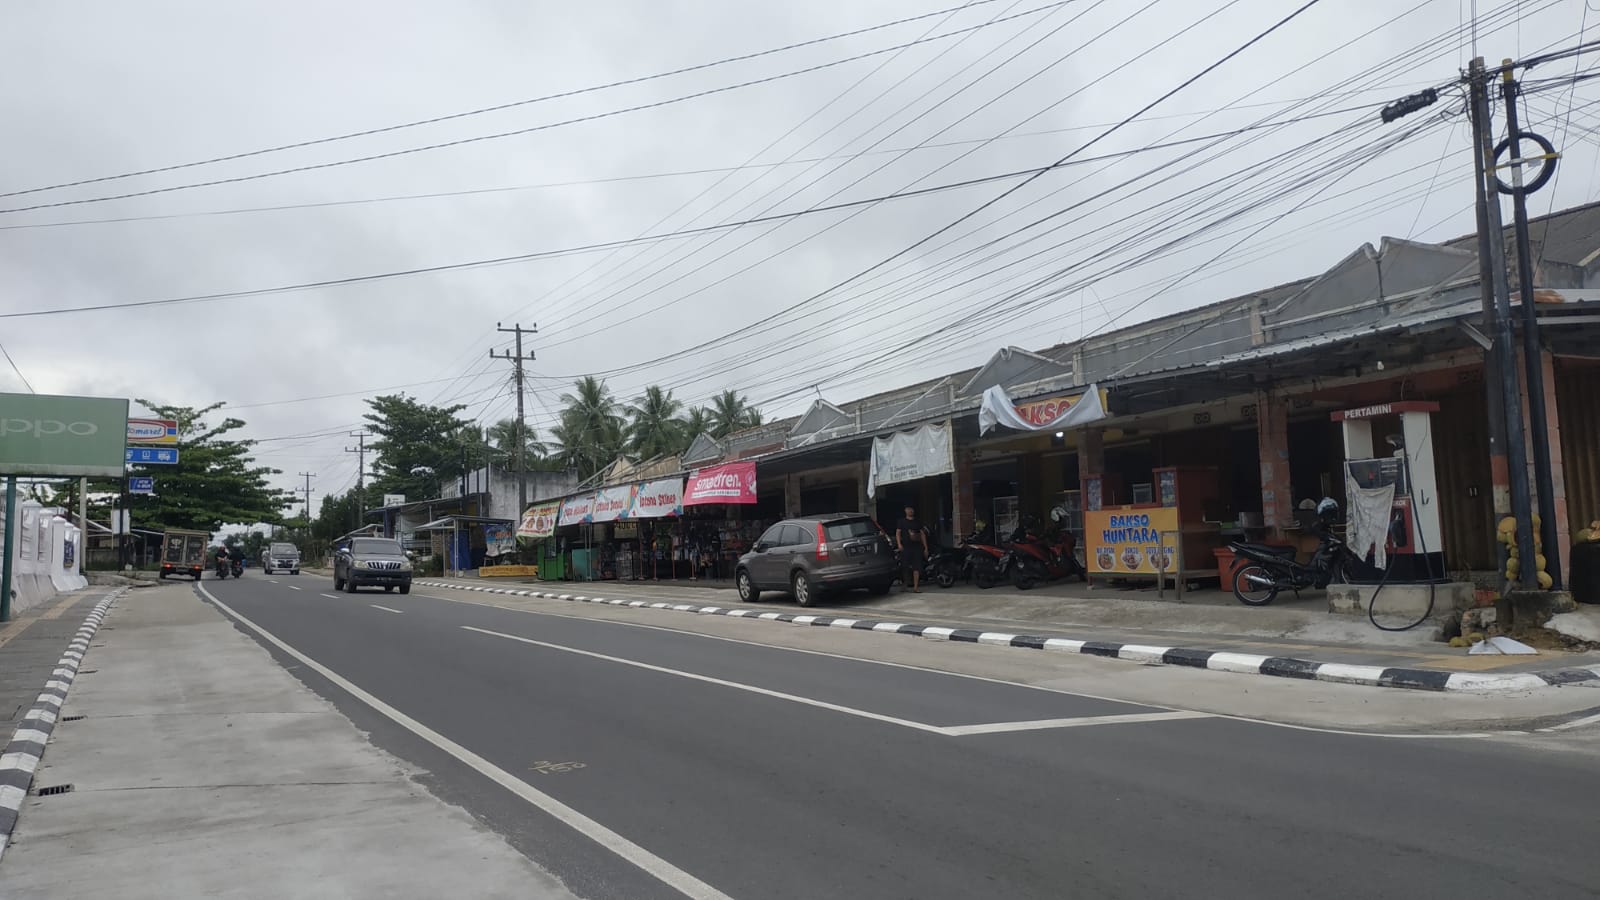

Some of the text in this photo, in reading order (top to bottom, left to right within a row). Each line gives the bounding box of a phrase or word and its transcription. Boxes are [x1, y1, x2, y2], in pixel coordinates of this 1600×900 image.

[1345, 404, 1392, 419] PERTAMINI
[1109, 514, 1150, 528] BAKSO
[1102, 528, 1160, 544] HUNTARA
